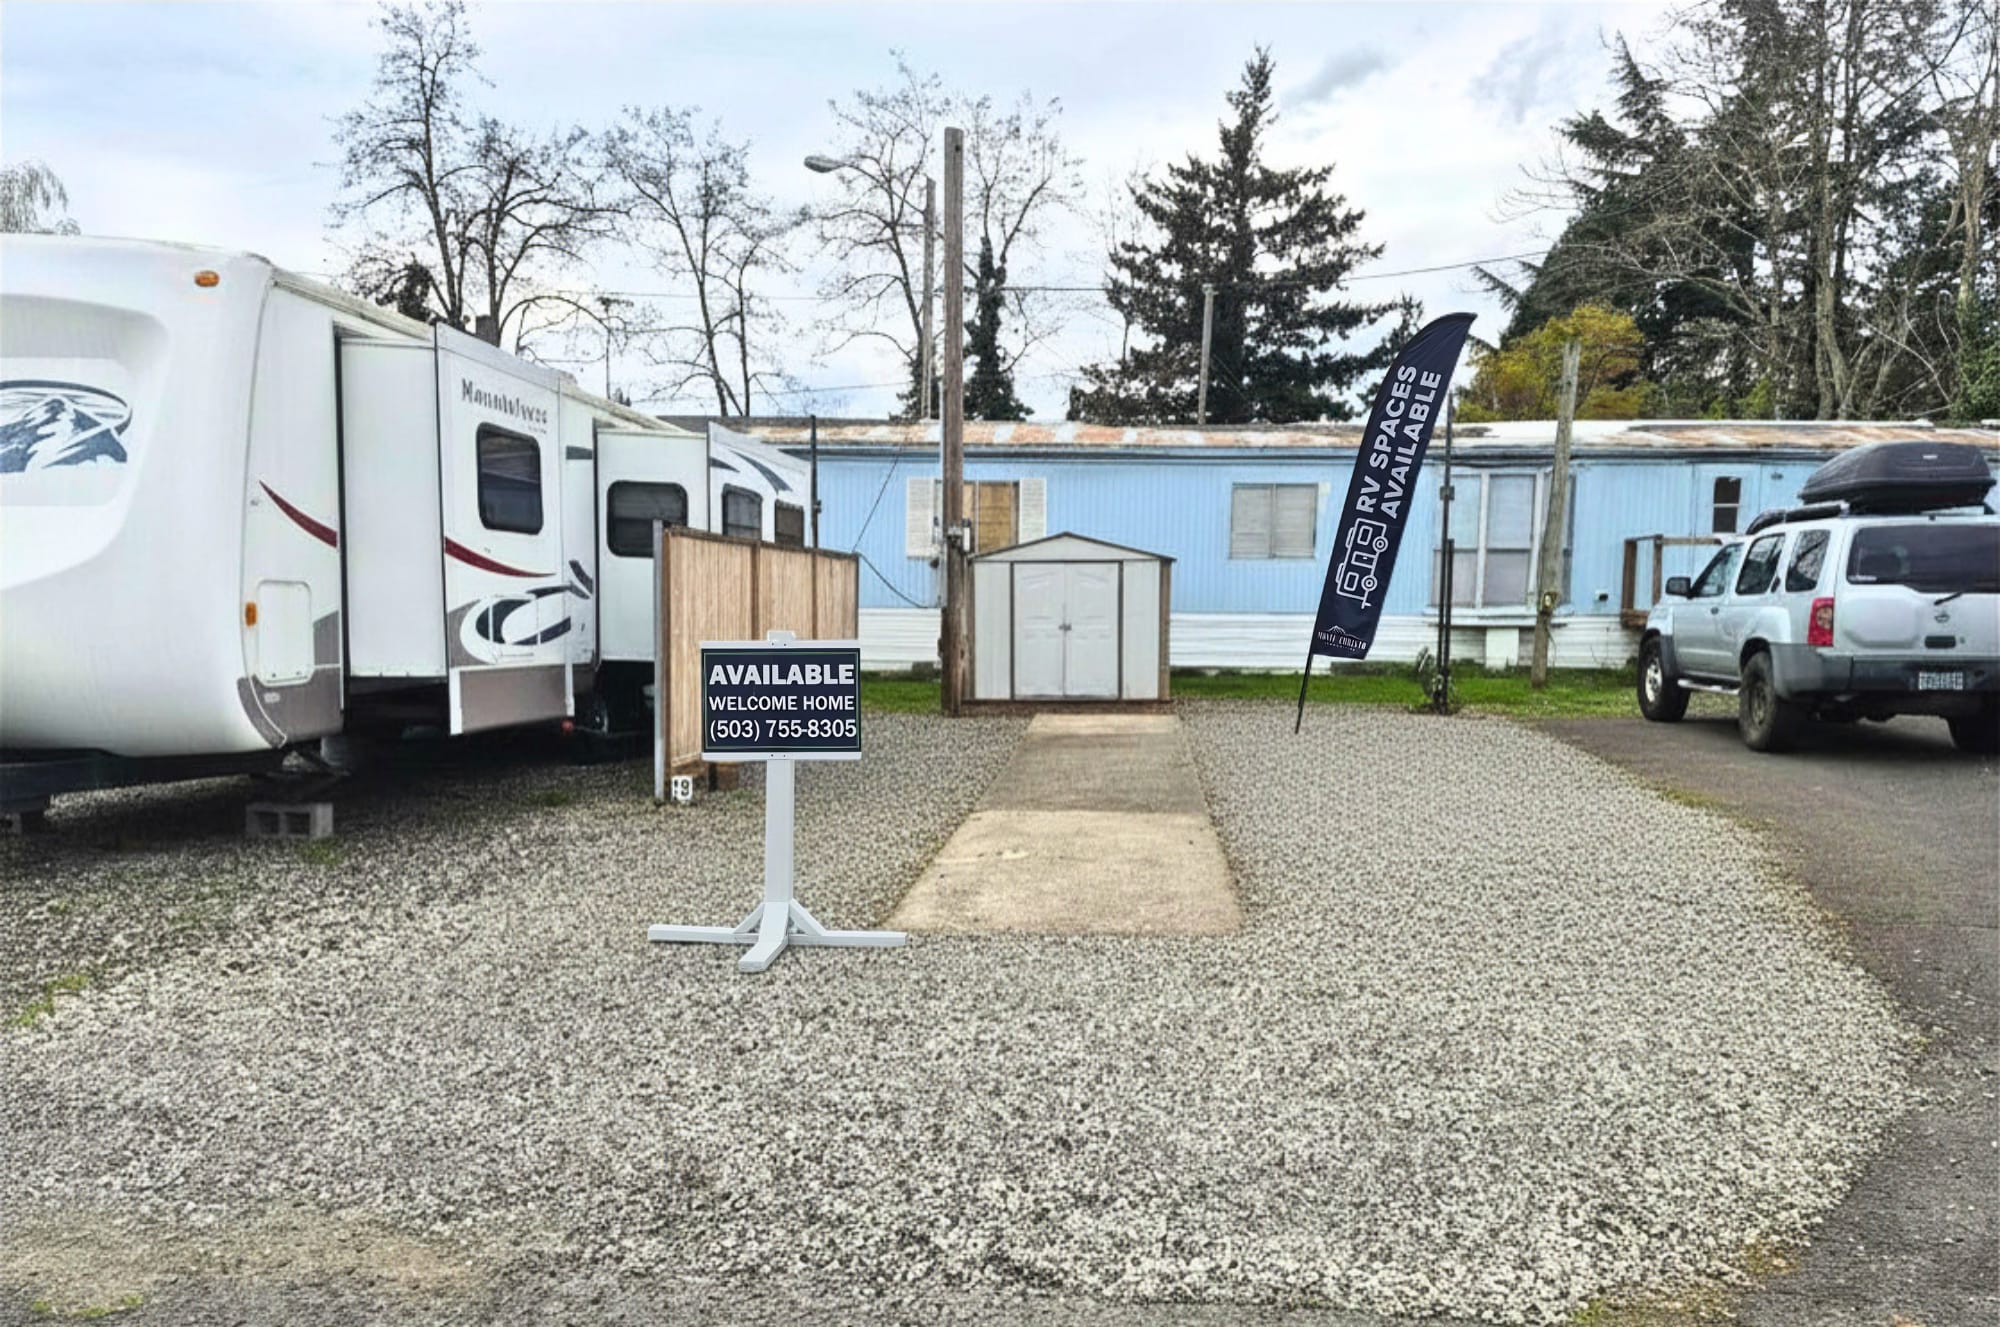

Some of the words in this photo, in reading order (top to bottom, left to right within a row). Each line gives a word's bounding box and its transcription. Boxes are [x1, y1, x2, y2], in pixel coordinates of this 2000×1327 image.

[1355, 475, 1381, 513] RV
[1369, 365, 1417, 470] SPACES
[1380, 371, 1442, 519] AVAILABLE
[709, 664, 855, 685] AVAILABLE
[709, 696, 798, 711] WELCOME
[803, 695, 855, 710] HOME
[710, 719, 760, 742] (503)
[765, 719, 857, 738] 755-8305
